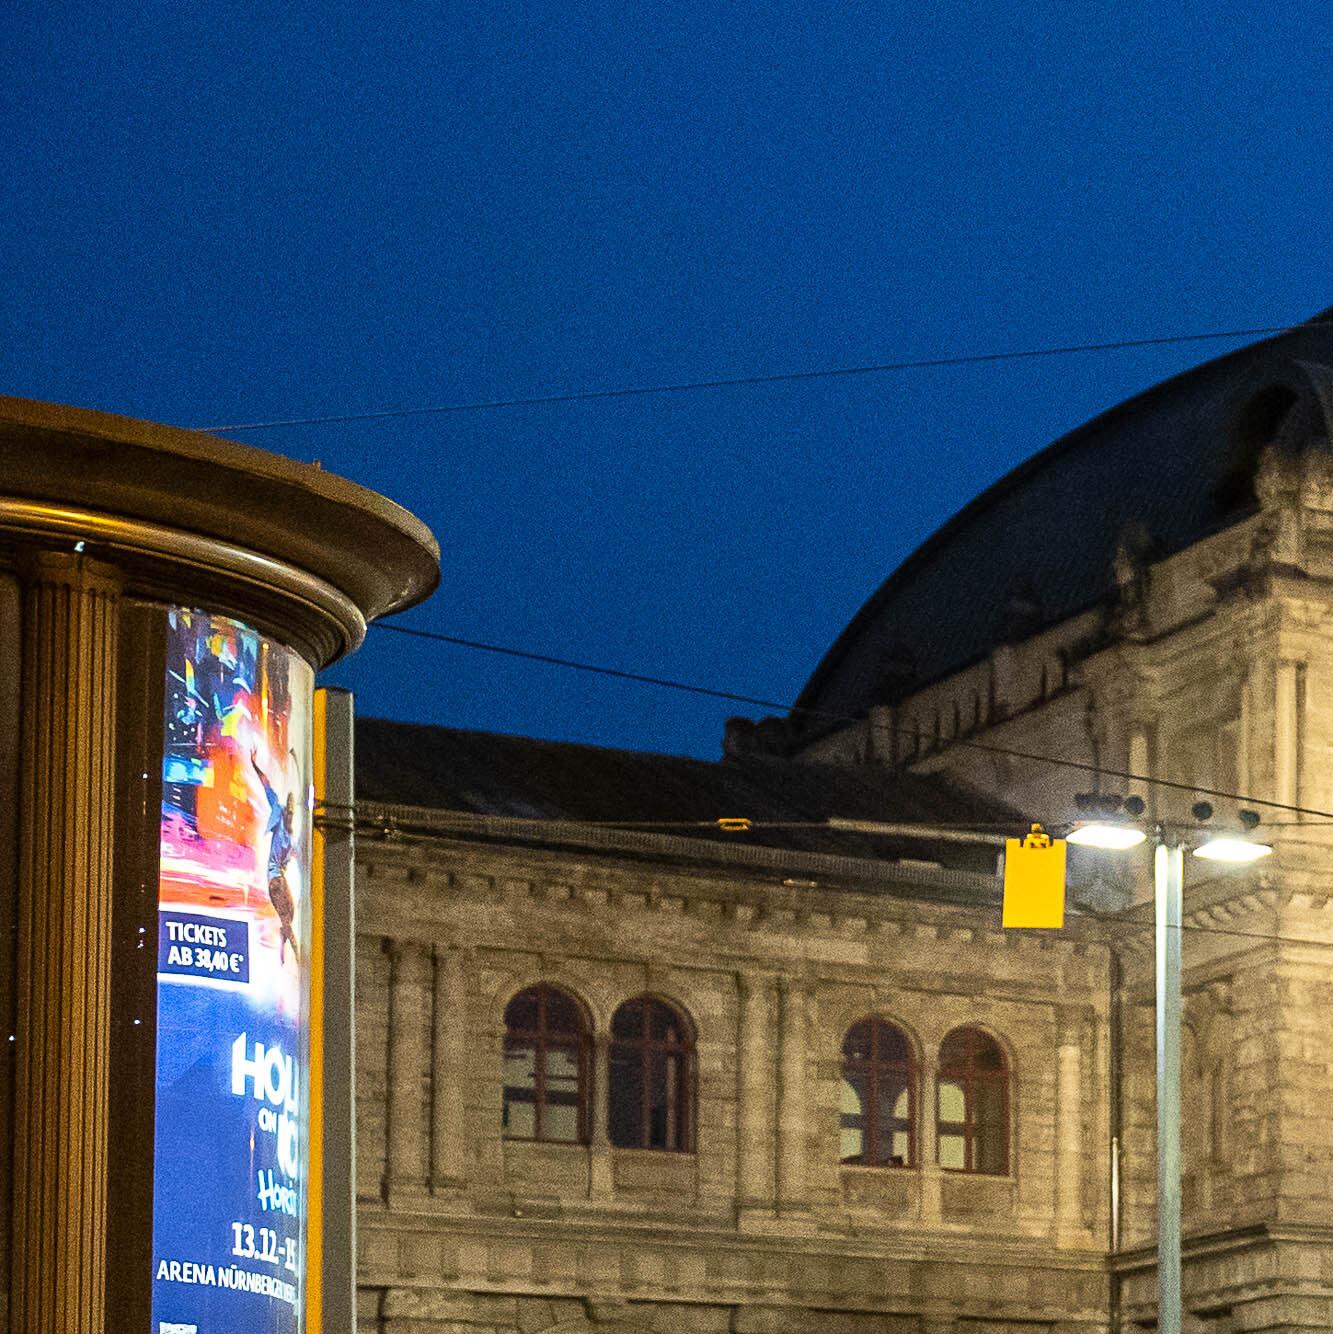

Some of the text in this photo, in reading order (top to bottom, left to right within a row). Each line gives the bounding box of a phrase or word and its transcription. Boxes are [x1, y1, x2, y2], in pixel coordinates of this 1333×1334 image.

[165, 921, 227, 948] TICKETS
[168, 945, 193, 966] AB
[258, 1107, 277, 1133] ON
[156, 1259, 217, 1286] ARENA
